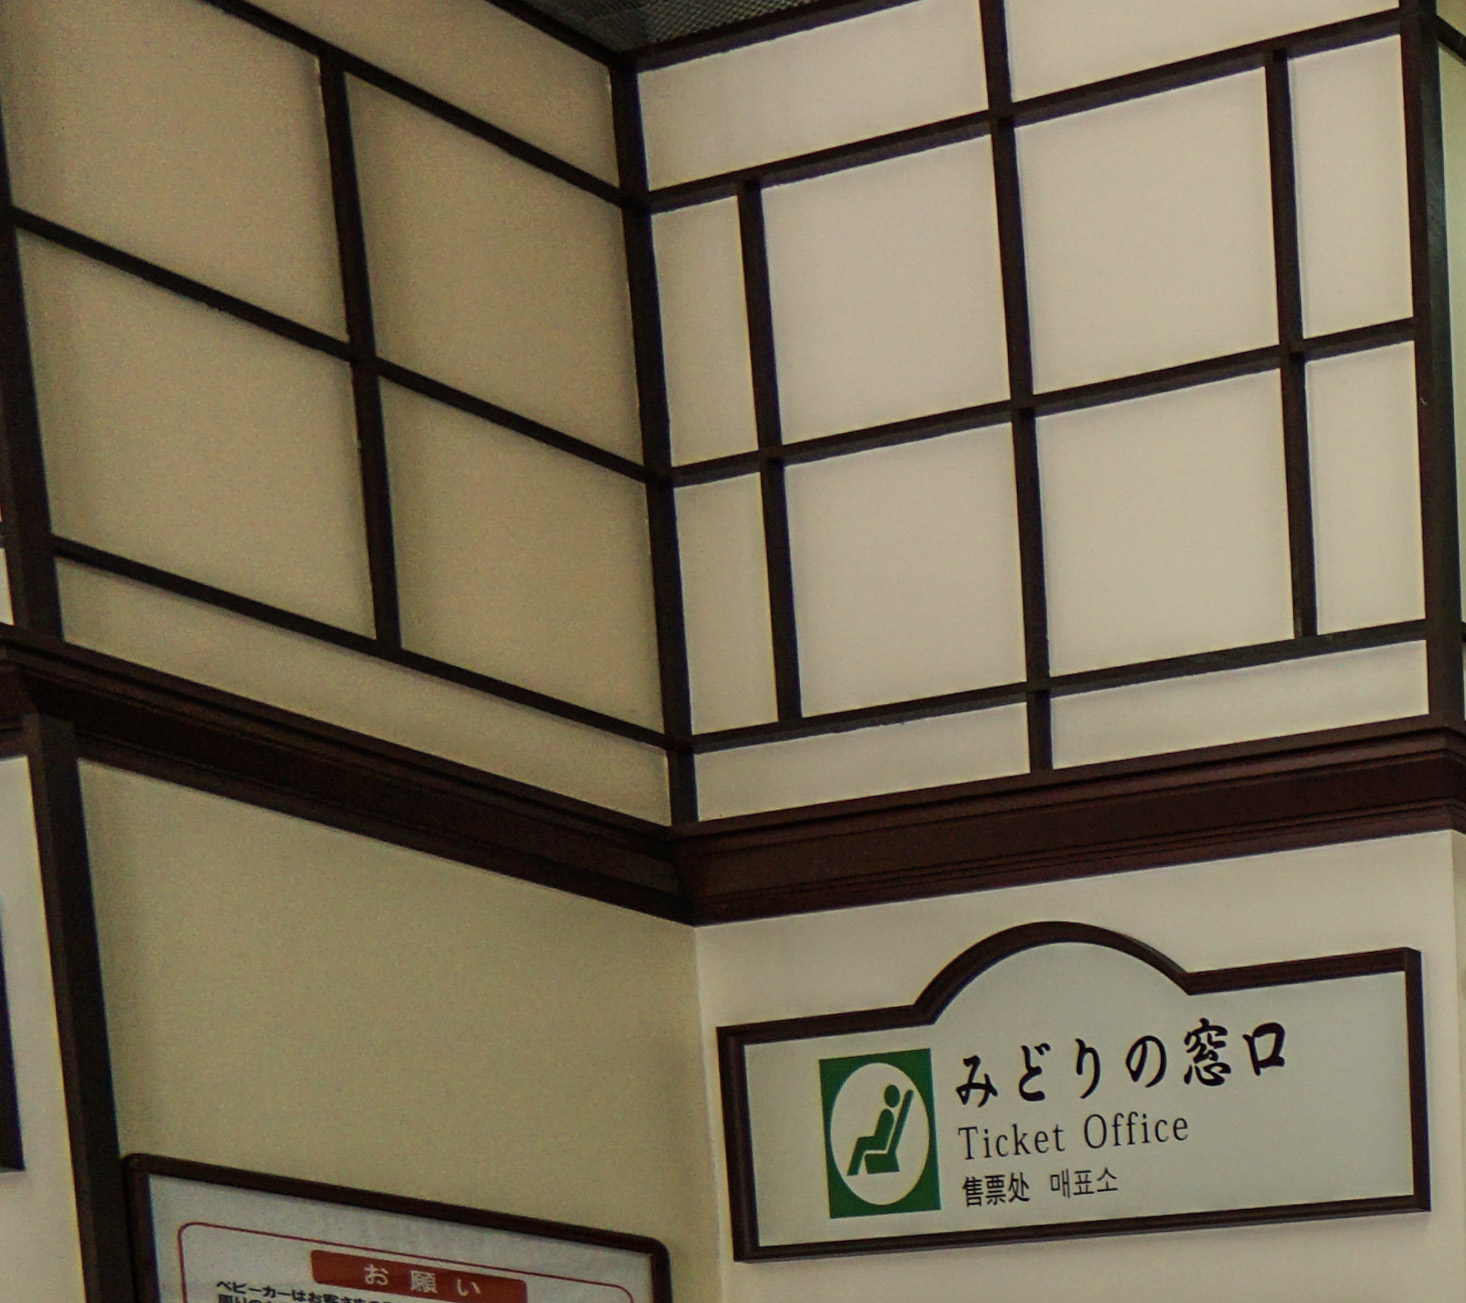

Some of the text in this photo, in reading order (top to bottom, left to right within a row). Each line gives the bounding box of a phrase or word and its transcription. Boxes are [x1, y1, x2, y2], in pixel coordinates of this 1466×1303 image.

[954, 1016, 1291, 1109] みどりの窓口
[957, 1112, 1192, 1162] Ticket Office
[961, 1172, 1031, 1208] 售票处
[1049, 1166, 1121, 1202] 매표소
[363, 1263, 482, 1297] お願い
